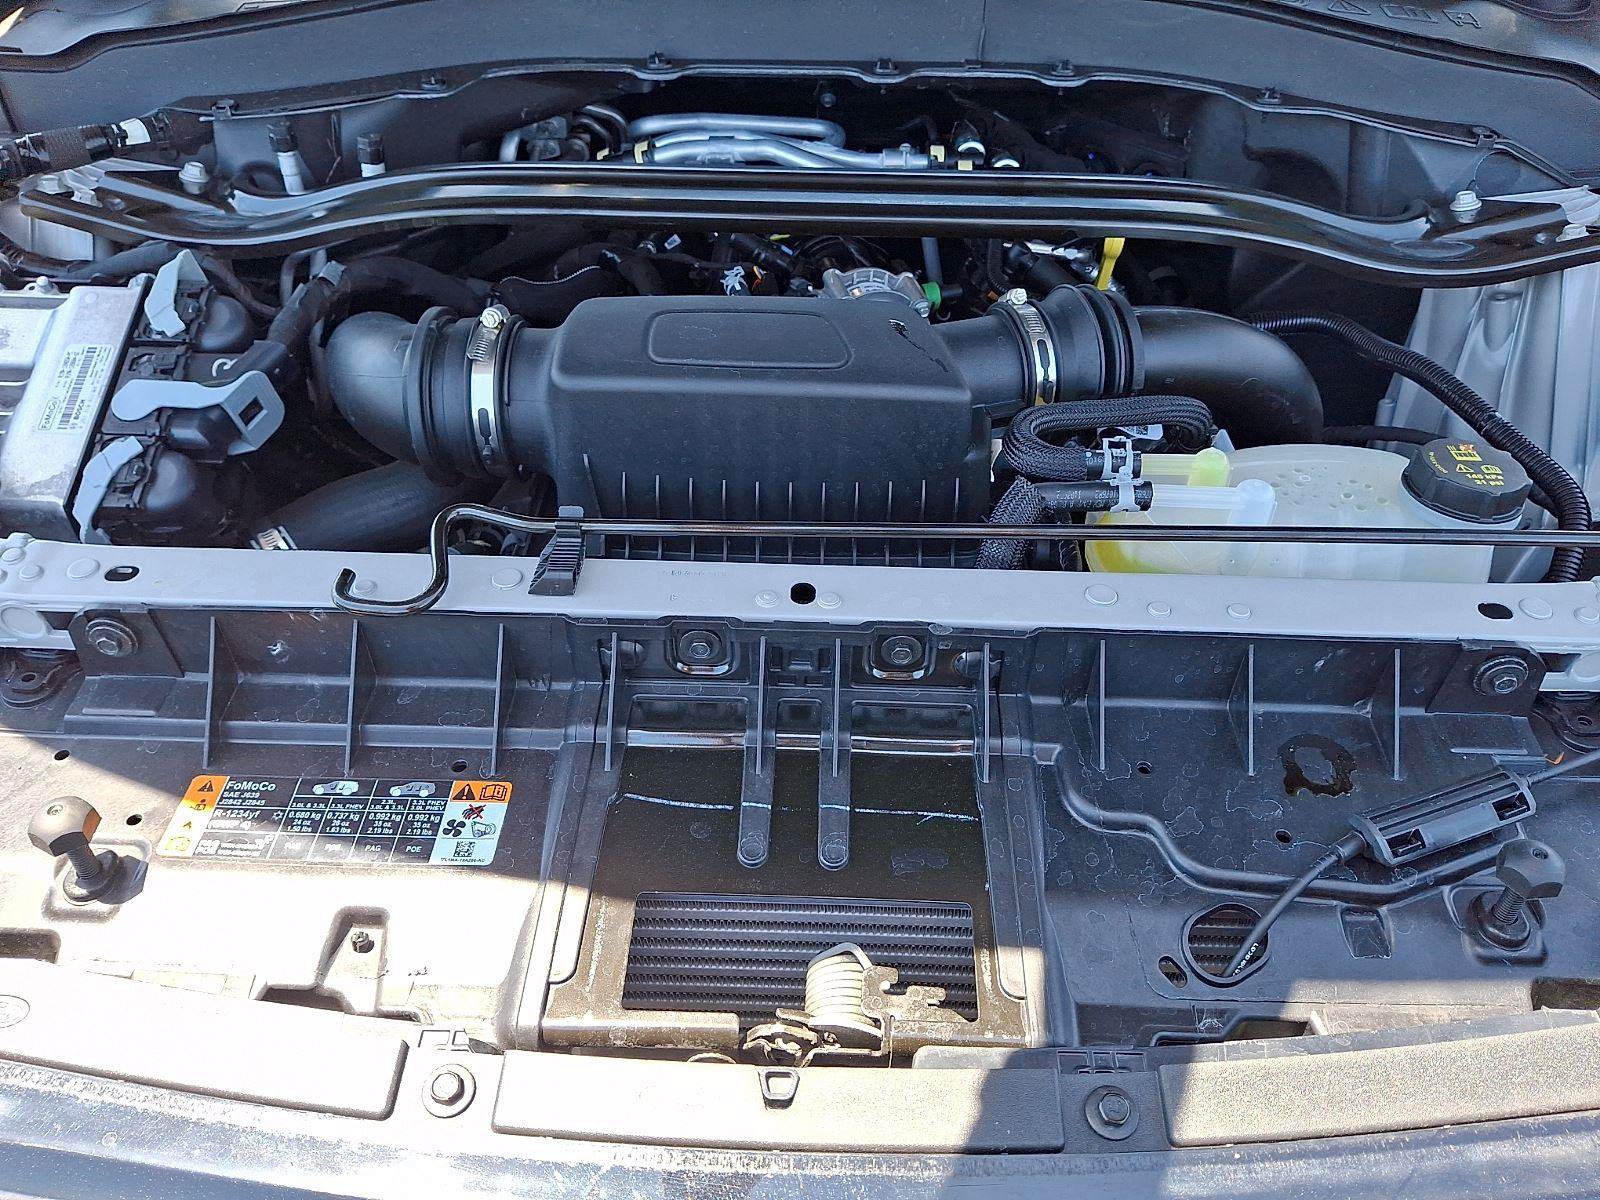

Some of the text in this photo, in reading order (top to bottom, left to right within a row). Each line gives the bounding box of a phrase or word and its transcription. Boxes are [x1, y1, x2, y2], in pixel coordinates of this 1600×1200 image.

[41, 400, 58, 430] FoMoCo
[74, 400, 86, 420] BOSCH
[226, 780, 276, 791] FoMoCo
[212, 809, 261, 820] R-1234yf
[310, 812, 322, 820] kg
[349, 812, 360, 821] kg
[430, 814, 440, 822] kg
